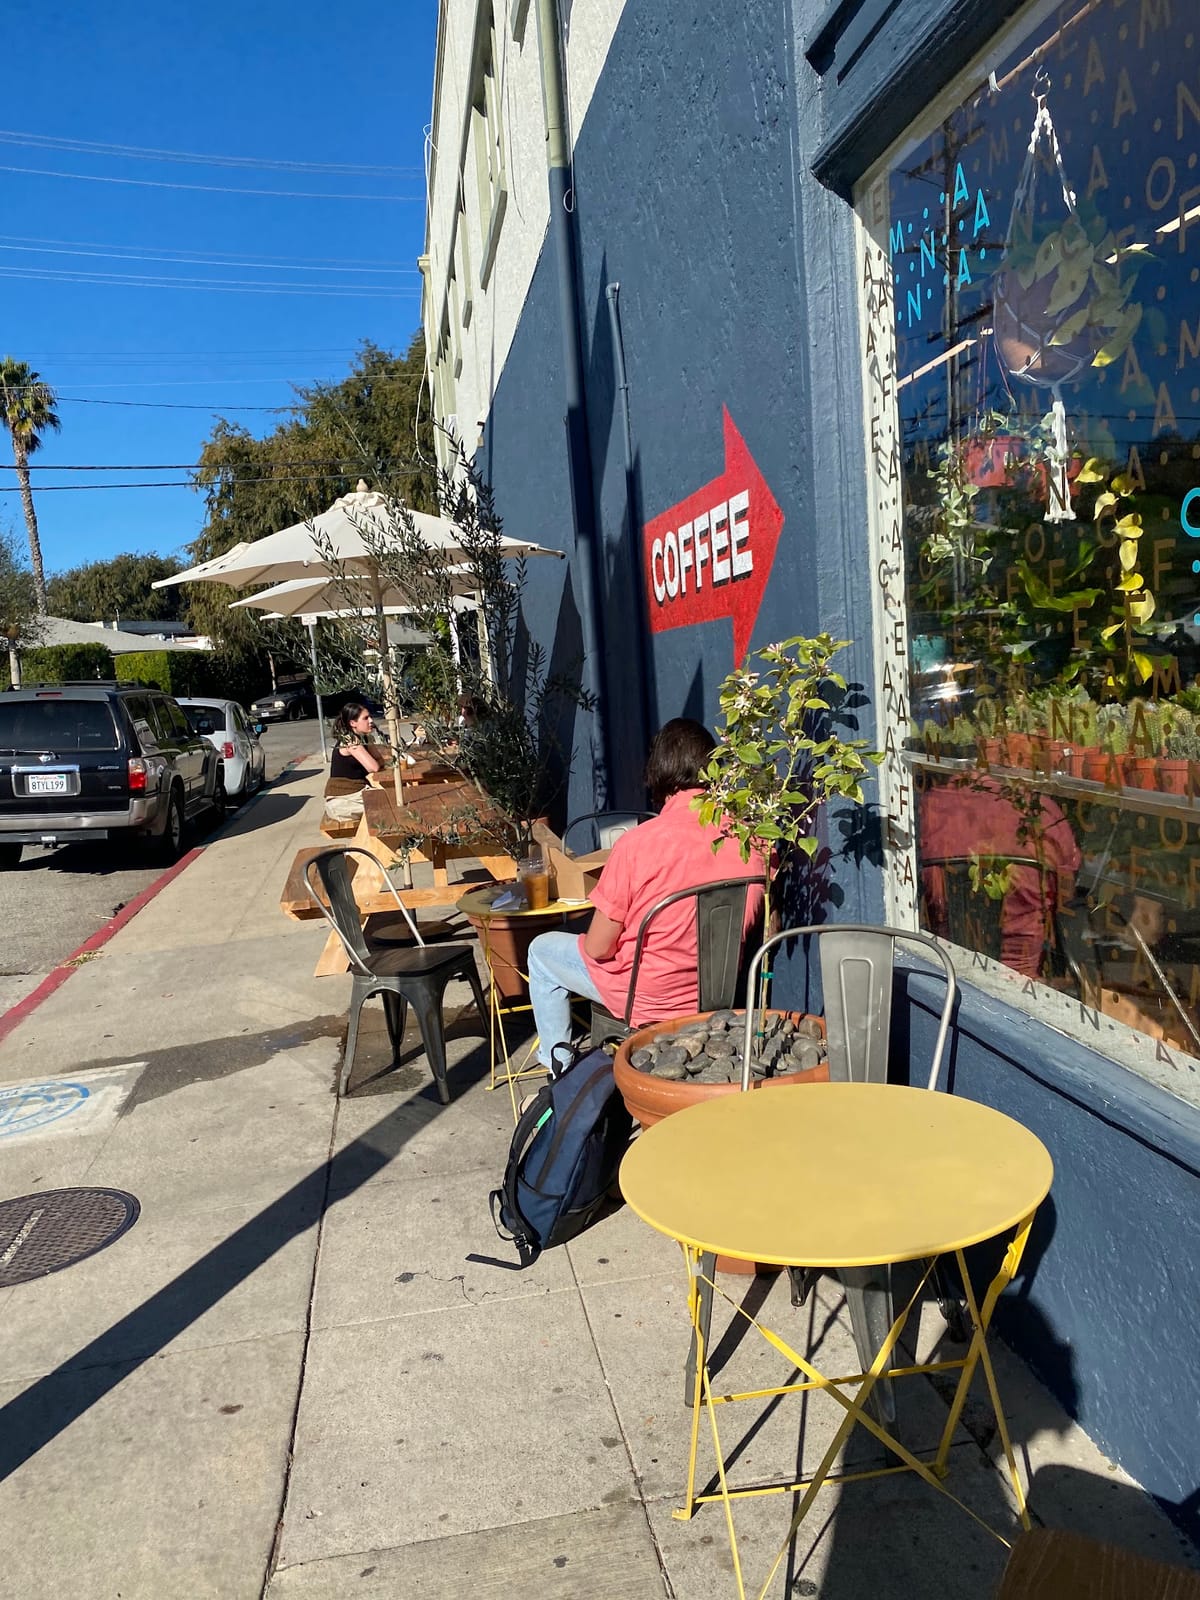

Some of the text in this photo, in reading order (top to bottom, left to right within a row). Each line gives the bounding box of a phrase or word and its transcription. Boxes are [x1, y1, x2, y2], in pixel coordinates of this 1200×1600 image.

[889, 161, 970, 264] M A
[972, 187, 991, 239] A
[907, 247, 973, 328] N A
[651, 489, 753, 604] COFFEE
